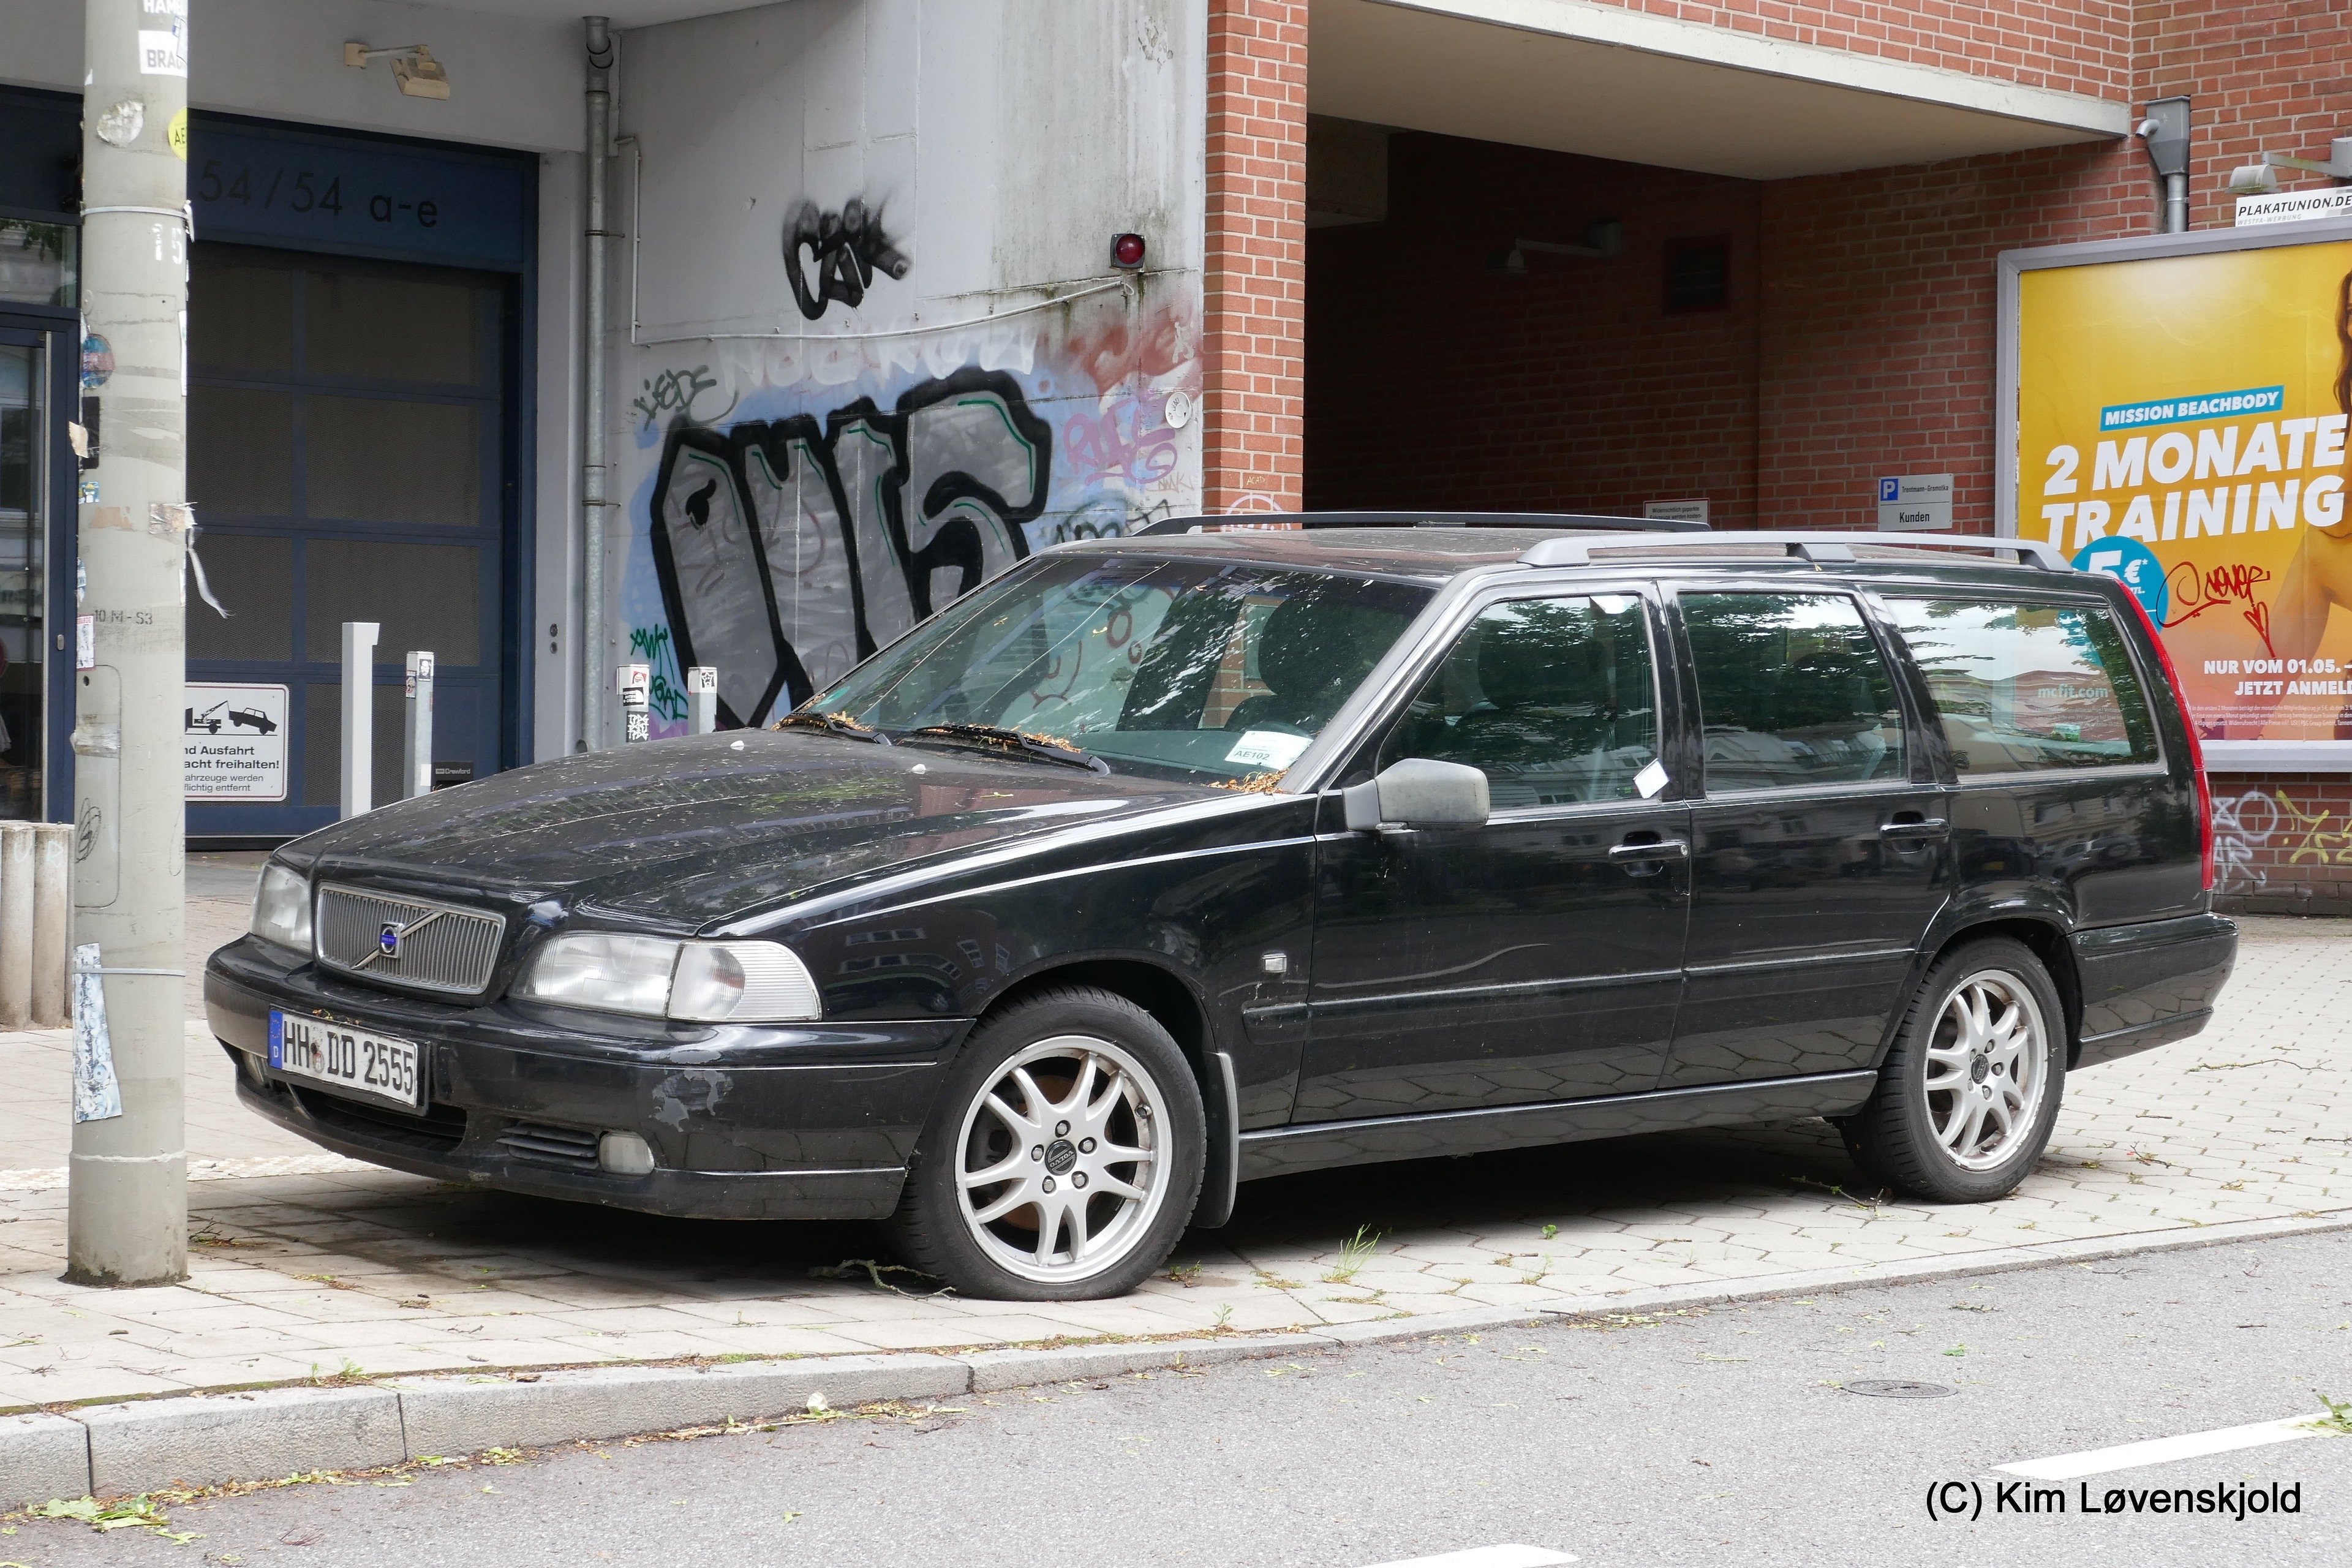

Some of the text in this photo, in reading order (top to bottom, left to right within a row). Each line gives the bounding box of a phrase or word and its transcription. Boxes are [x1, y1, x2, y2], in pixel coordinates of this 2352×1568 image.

[370, 194, 437, 228] a-e
[2238, 195, 2352, 217] PLAKATUNION.DE
[2237, 214, 2302, 226] WESTFA-WERBUNG
[2105, 391, 2279, 426] MISSION BEACHBODY
[2044, 413, 2348, 496] 2 MONATE
[1899, 511, 1929, 523] Kunden
[2041, 475, 2345, 551] TRAINING
[2204, 660, 2239, 674] NUR
[2242, 659, 2283, 674] VOM
[2287, 659, 2341, 674] 01.05.
[2038, 684, 2109, 698] mcfit.com
[2234, 680, 2283, 696] JETZT
[200, 746, 255, 755] Ausfahrt
[1234, 750, 1270, 760] AE102
[216, 760, 279, 769] freihalten!
[185, 774, 227, 783] ahrzeuge
[273, 1046, 279, 1058] D
[284, 1020, 413, 1096] HH DD 2555
[1049, 1150, 1074, 1167] VOLVO
